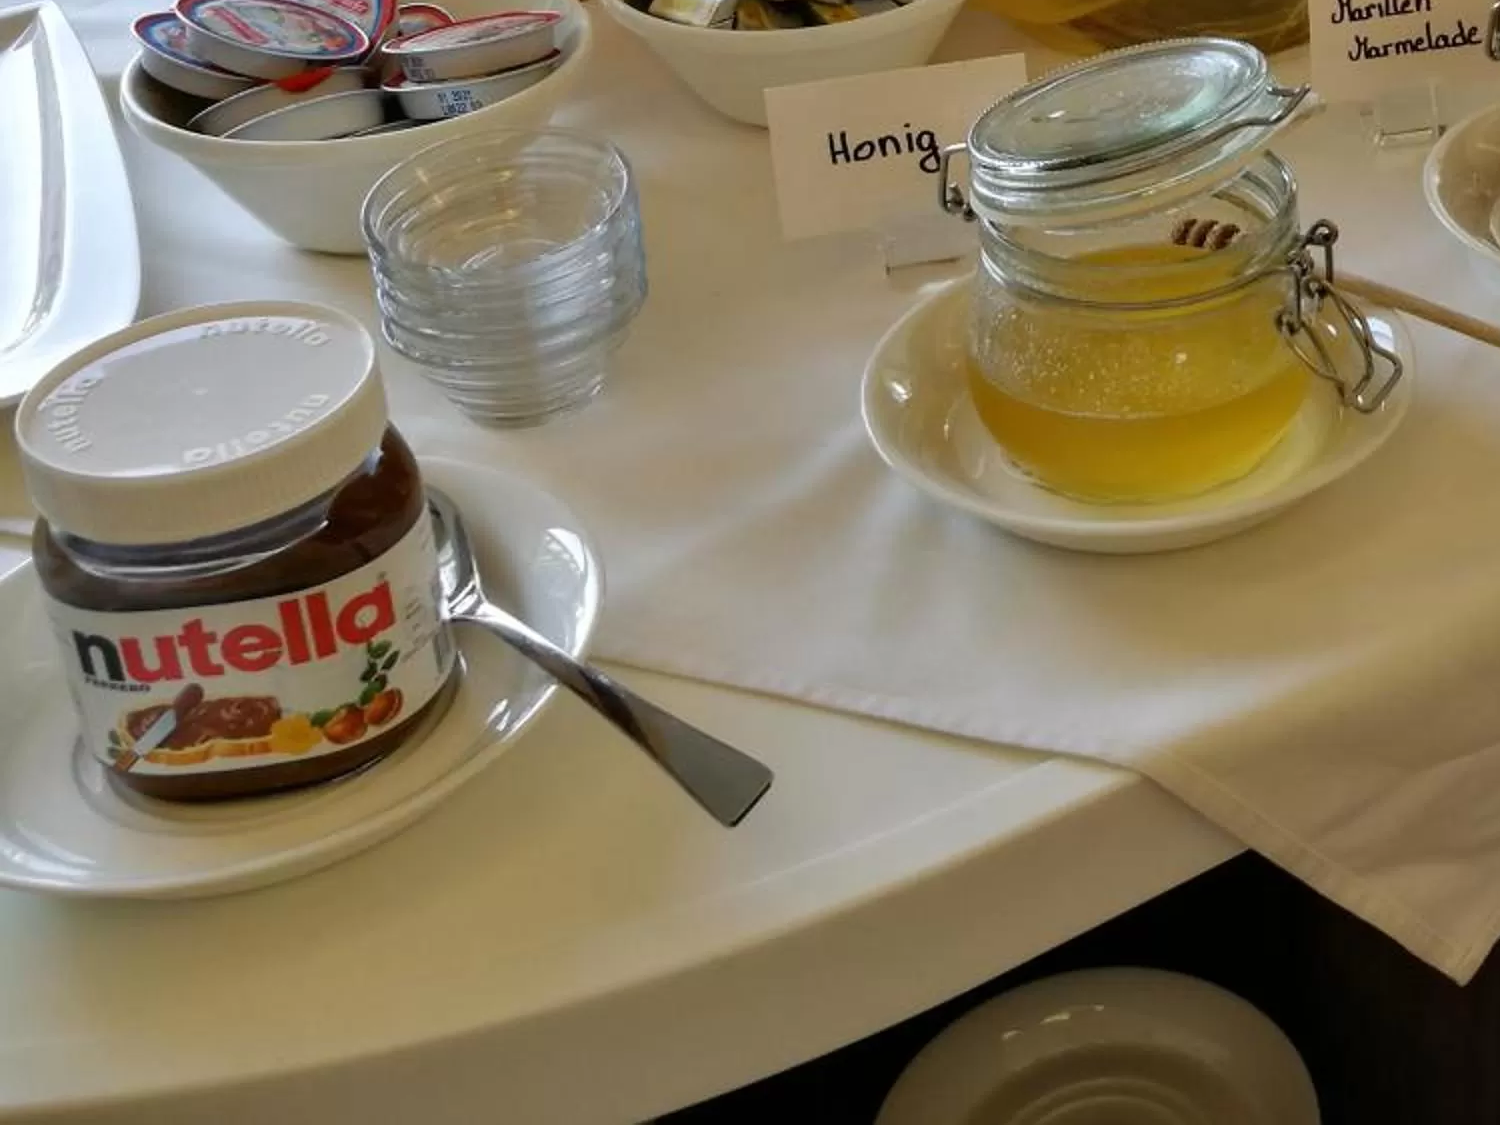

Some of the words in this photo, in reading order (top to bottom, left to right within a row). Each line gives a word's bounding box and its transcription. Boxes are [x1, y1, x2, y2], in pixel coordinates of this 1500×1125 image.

[1348, 19, 1482, 62] Marmelade
[827, 122, 942, 174] Honig
[72, 579, 397, 684] nutella
